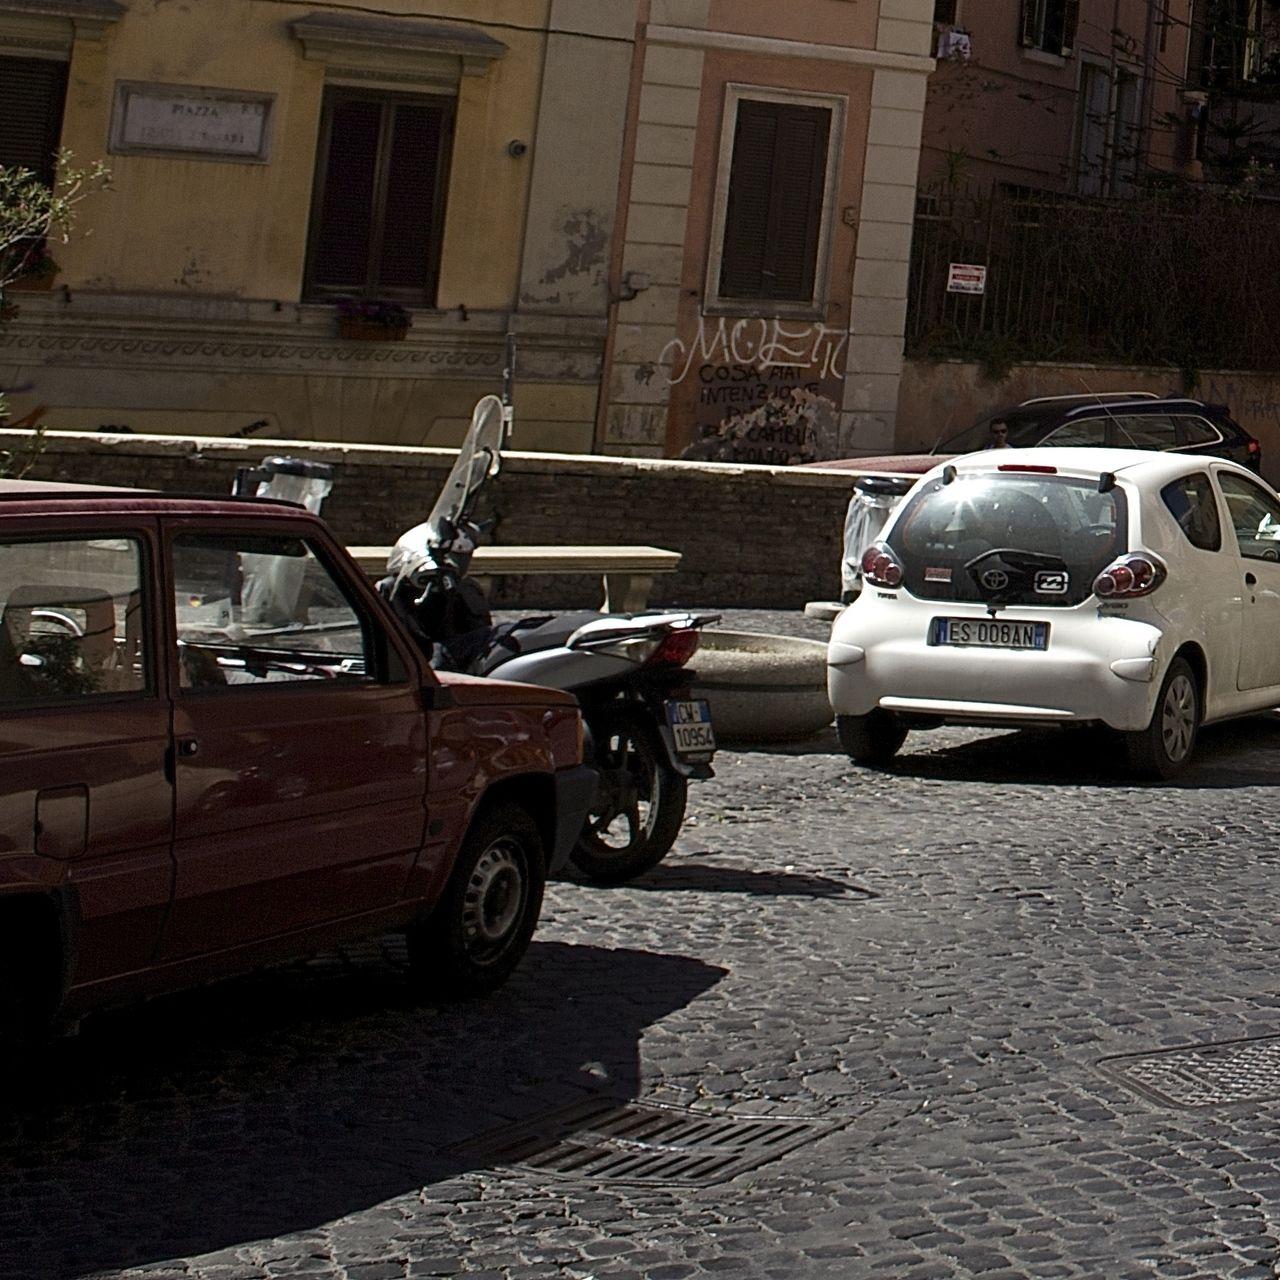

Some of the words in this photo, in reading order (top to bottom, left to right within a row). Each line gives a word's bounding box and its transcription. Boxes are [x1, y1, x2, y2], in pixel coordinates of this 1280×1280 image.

[699, 363, 761, 384] COSA
[699, 382, 820, 405] INTENZIOE
[949, 622, 971, 642] ES
[977, 623, 1034, 646] 008AN
